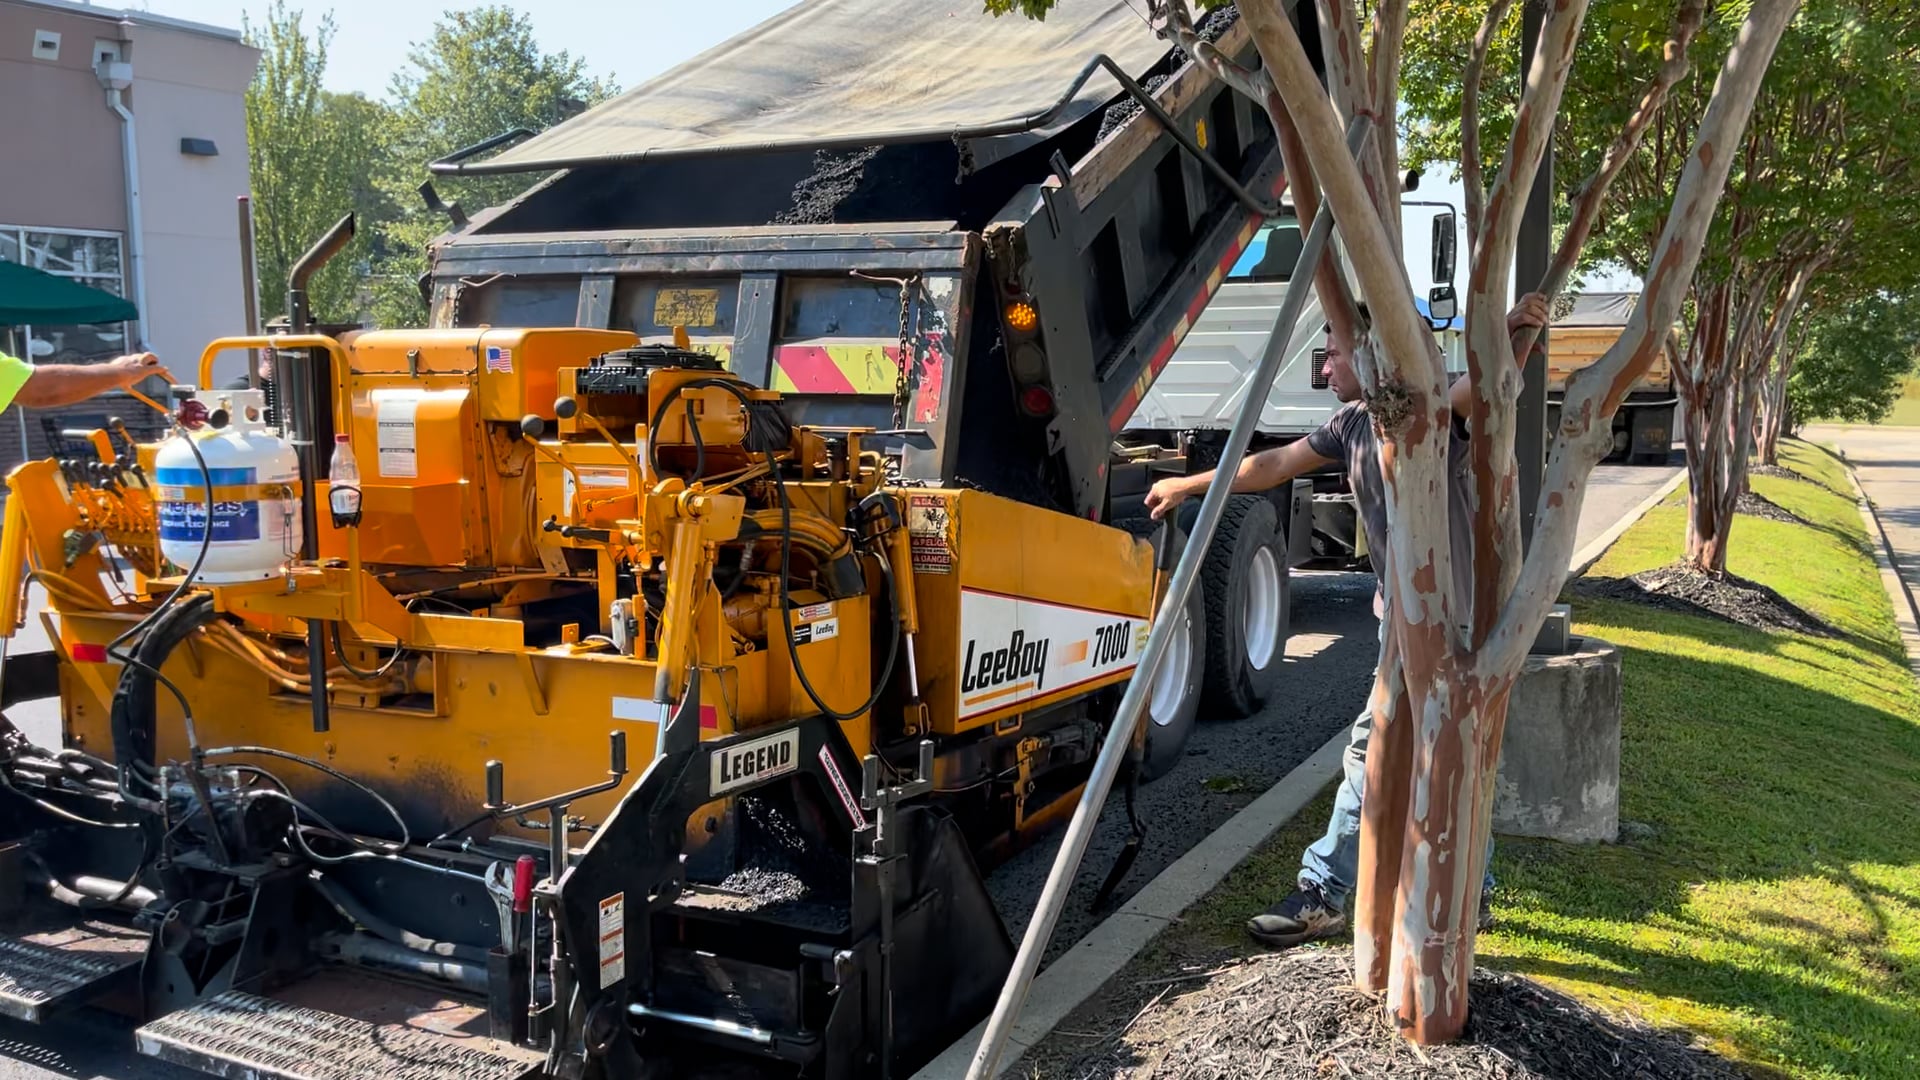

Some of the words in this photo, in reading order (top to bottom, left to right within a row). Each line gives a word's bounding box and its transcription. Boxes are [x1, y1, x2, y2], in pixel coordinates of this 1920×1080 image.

[961, 629, 1049, 693] LeeBoy
[1092, 620, 1131, 668] 7000
[720, 740, 791, 784] LEGEND
